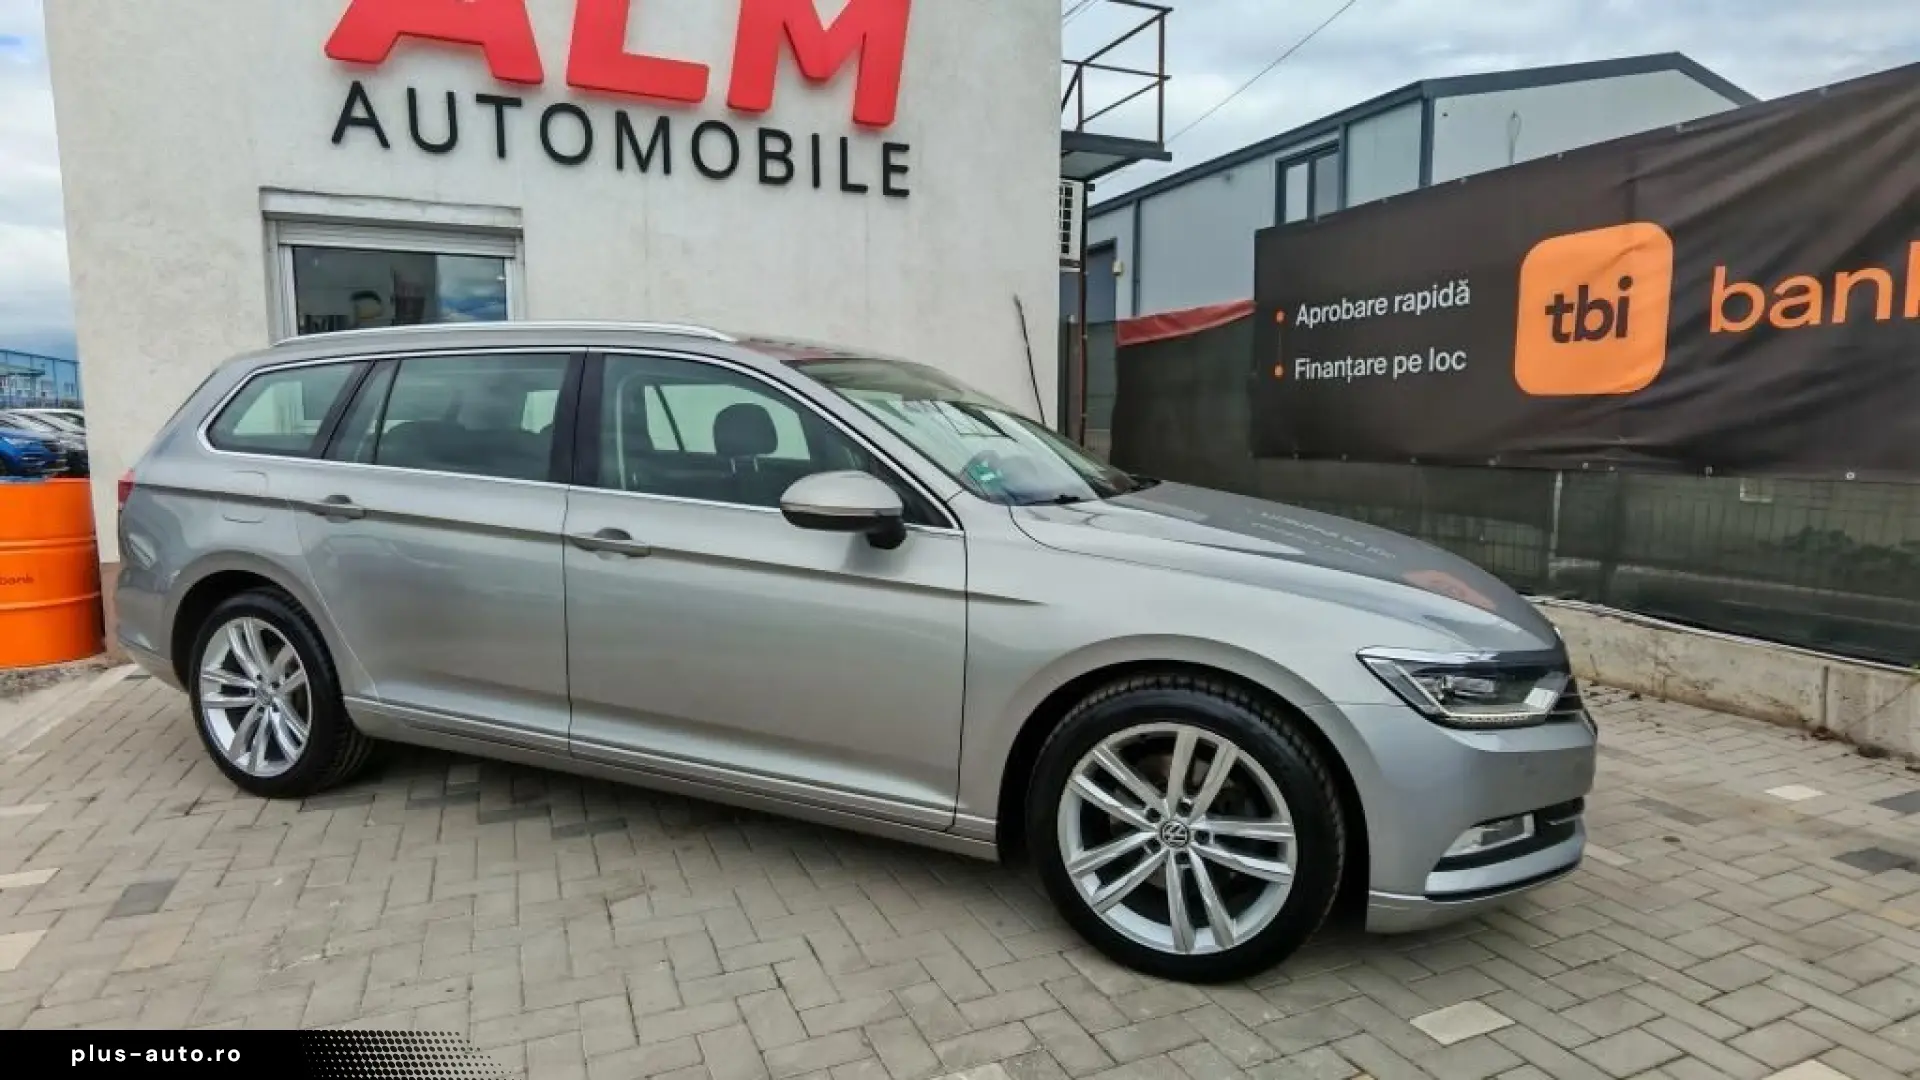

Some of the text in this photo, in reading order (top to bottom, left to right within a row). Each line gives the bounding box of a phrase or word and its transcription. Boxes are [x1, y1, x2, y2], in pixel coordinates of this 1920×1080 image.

[330, 81, 911, 198] AUTOMOBILE
[1295, 278, 1471, 329] Aprobare rapidă
[1544, 275, 1634, 344] tbi
[1294, 346, 1468, 383] Finanțare pe loc
